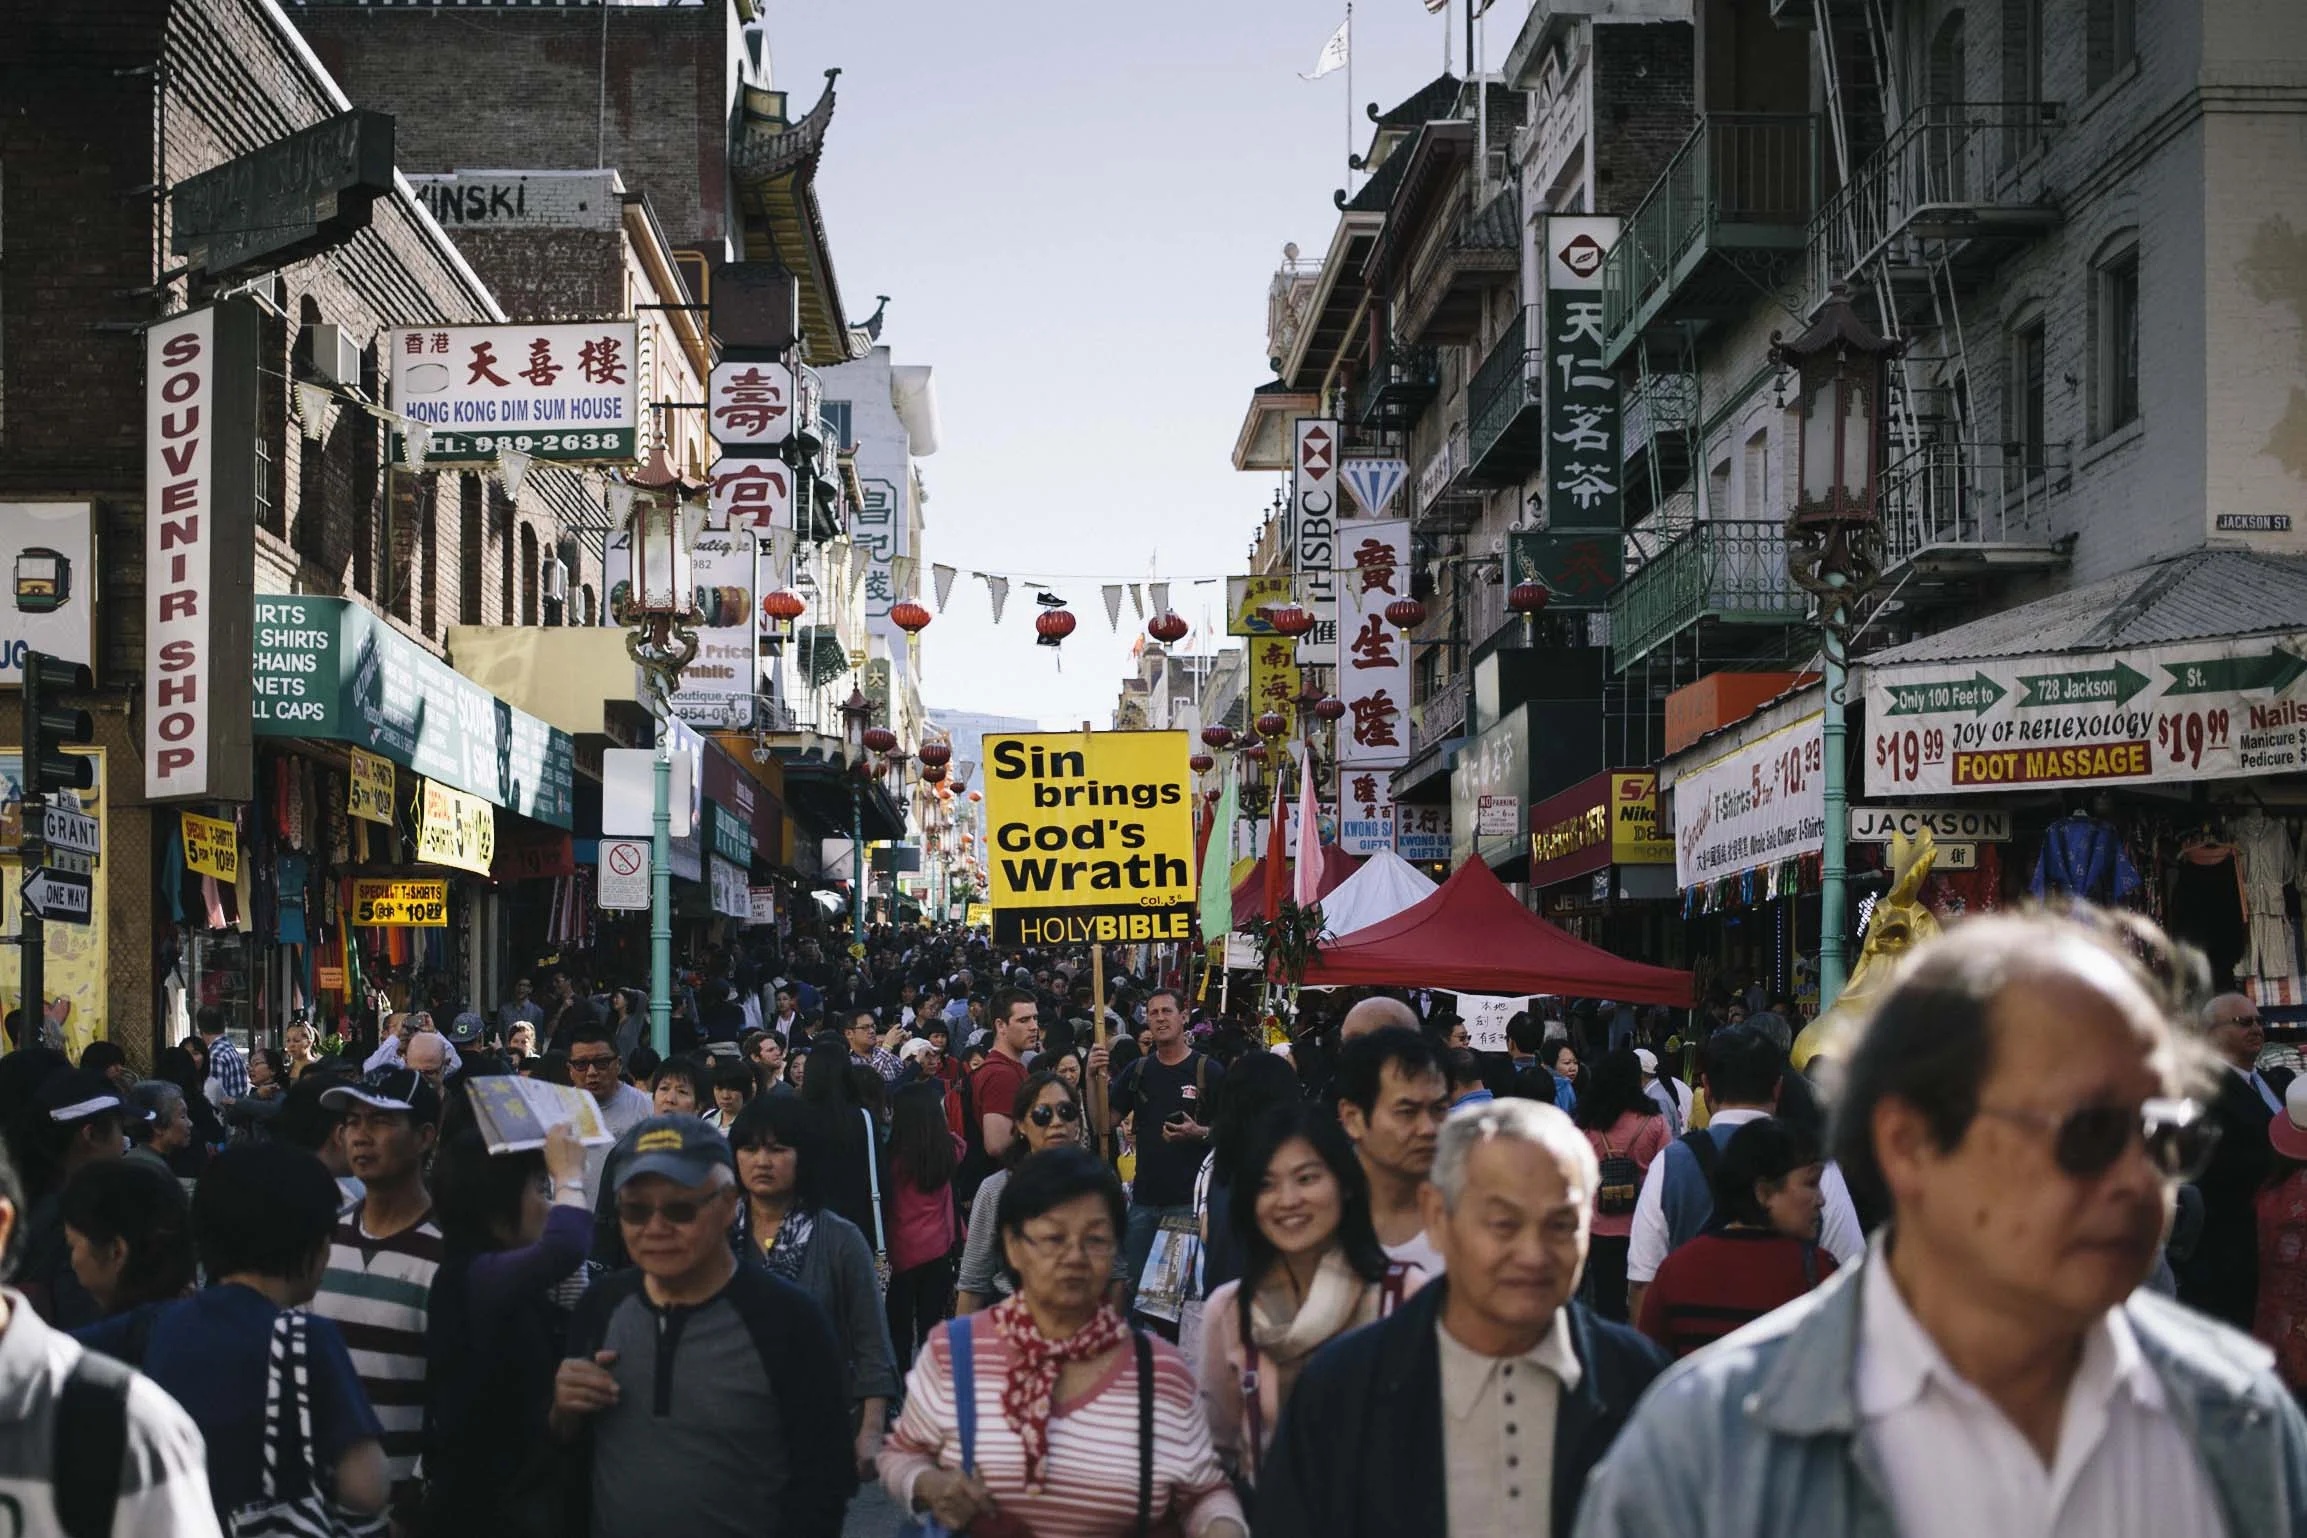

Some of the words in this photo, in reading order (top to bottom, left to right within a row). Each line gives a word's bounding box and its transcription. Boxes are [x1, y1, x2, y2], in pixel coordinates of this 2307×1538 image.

[405, 332, 449, 355] 香港
[467, 336, 628, 388] 天喜樓
[406, 402, 449, 424] HONG
[454, 400, 496, 422] KONG
[502, 400, 528, 421] DIM
[533, 398, 565, 420] SUM
[571, 397, 622, 419] HOUSE
[430, 437, 467, 453] EL:
[475, 433, 620, 452] 989-2638
[160, 331, 201, 624] SOUVENIR
[2221, 516, 2271, 529] JACKSON
[1301, 491, 1332, 601] HSBC
[260, 629, 329, 649] SHIRTS
[2038, 679, 2060, 700] 728
[2063, 674, 2117, 698] Jackson
[2186, 667, 2206, 687] St.
[157, 639, 197, 779] SHOP
[275, 701, 325, 721] CAPS
[1899, 690, 1925, 712] Only
[1928, 687, 1949, 707] 100
[1952, 686, 1978, 705] Feet
[1981, 687, 1993, 703] to
[2250, 700, 2307, 730] Nails
[1952, 721, 1987, 749] JOY
[1992, 720, 2014, 742] OF
[2019, 711, 2154, 741] REFLEXOLOGY
[2240, 732, 2295, 750] Manicure
[993, 741, 1085, 780] Sin
[1958, 753, 2019, 782] FOOT
[2026, 744, 2145, 780] MASSAGE
[2241, 752, 2294, 769] Pedicure
[352, 780, 363, 809] 5
[1034, 780, 1181, 809] brings
[1752, 763, 1760, 809] 5
[47, 812, 96, 848] GRANT
[997, 819, 1146, 852] God's
[1344, 820, 1378, 837] KWONG
[1857, 813, 2001, 836] JACKSON
[188, 839, 199, 863] 5
[1360, 840, 1391, 851] GIFTS
[1400, 834, 1434, 847] KWONG
[1409, 847, 1444, 858] GIFTS
[1000, 853, 1188, 892] Wrath
[46, 884, 64, 905] ONE
[67, 886, 86, 907] WAY
[1140, 896, 1163, 906] Col.
[359, 902, 374, 921] 5
